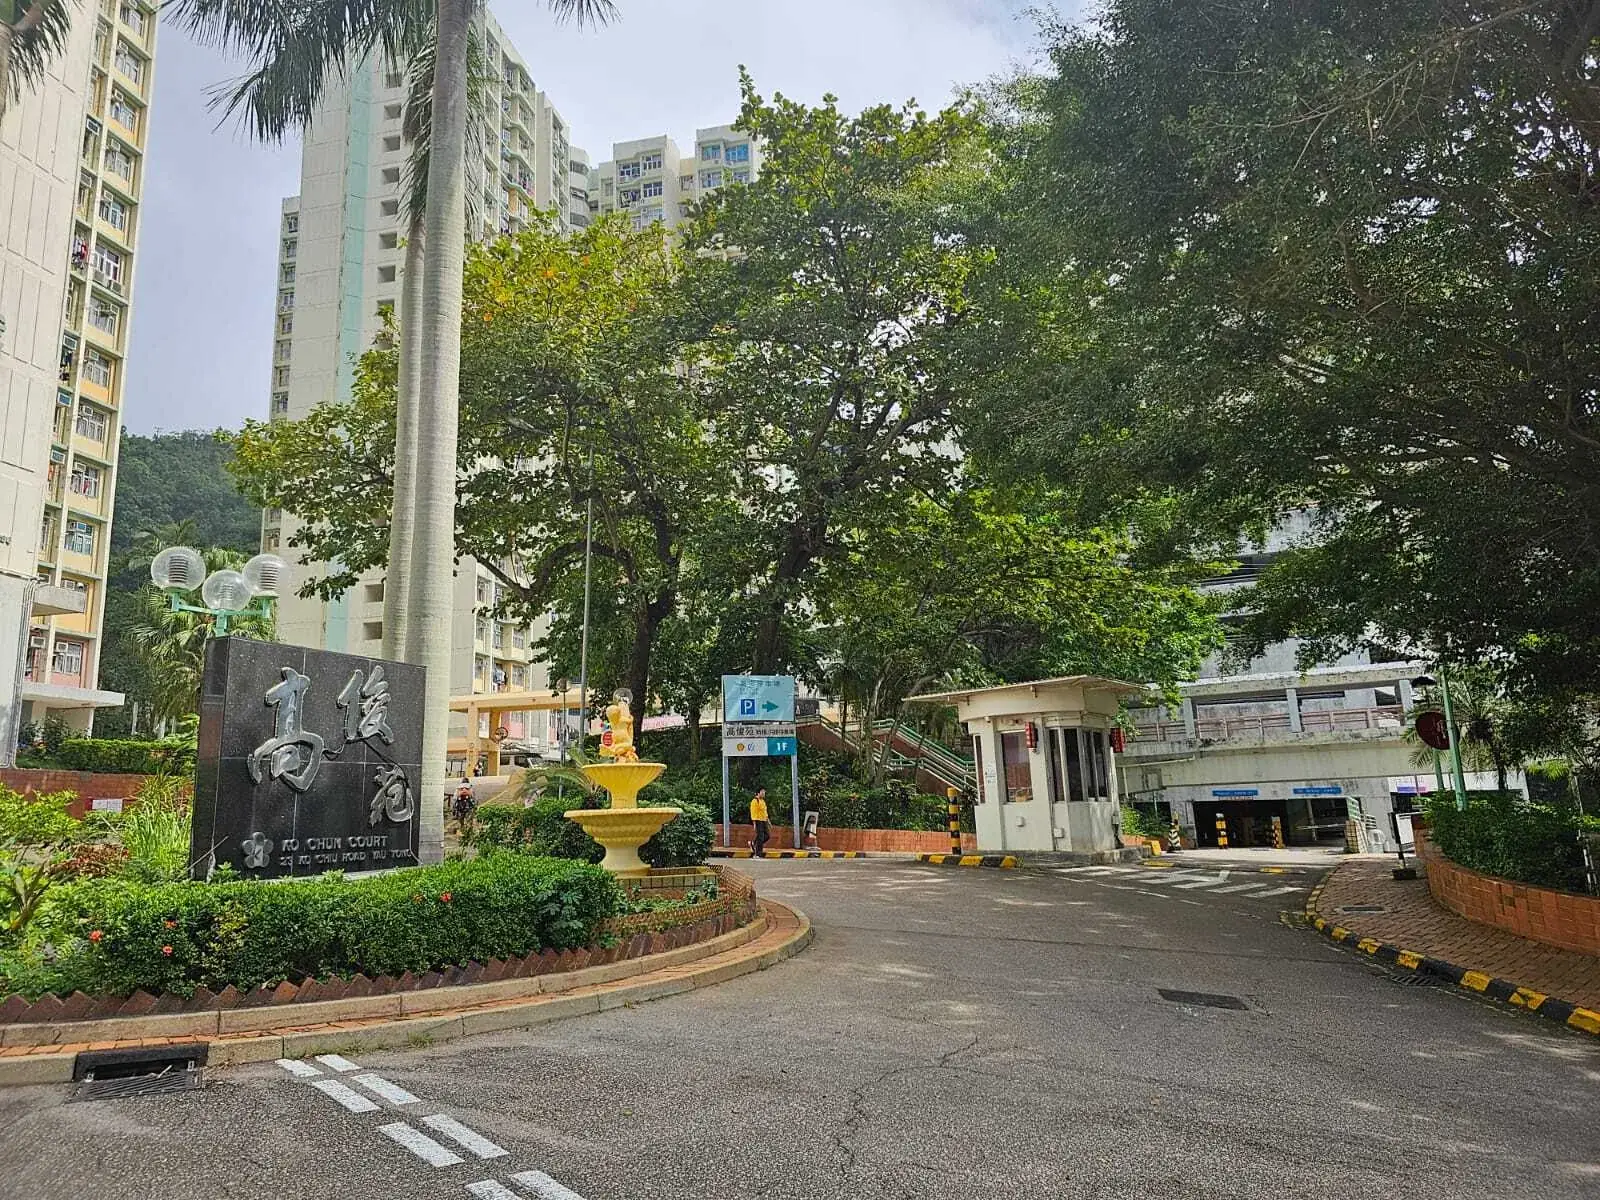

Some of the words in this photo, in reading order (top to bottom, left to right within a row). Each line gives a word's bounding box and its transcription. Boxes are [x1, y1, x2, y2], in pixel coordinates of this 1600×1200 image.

[744, 700, 753, 713] P
[776, 742, 788, 752] 1F
[282, 839, 299, 851] KO
[307, 838, 342, 850] CHUN
[349, 836, 388, 847] COURT
[316, 853, 338, 864] CHIU
[343, 852, 366, 862] ROAD
